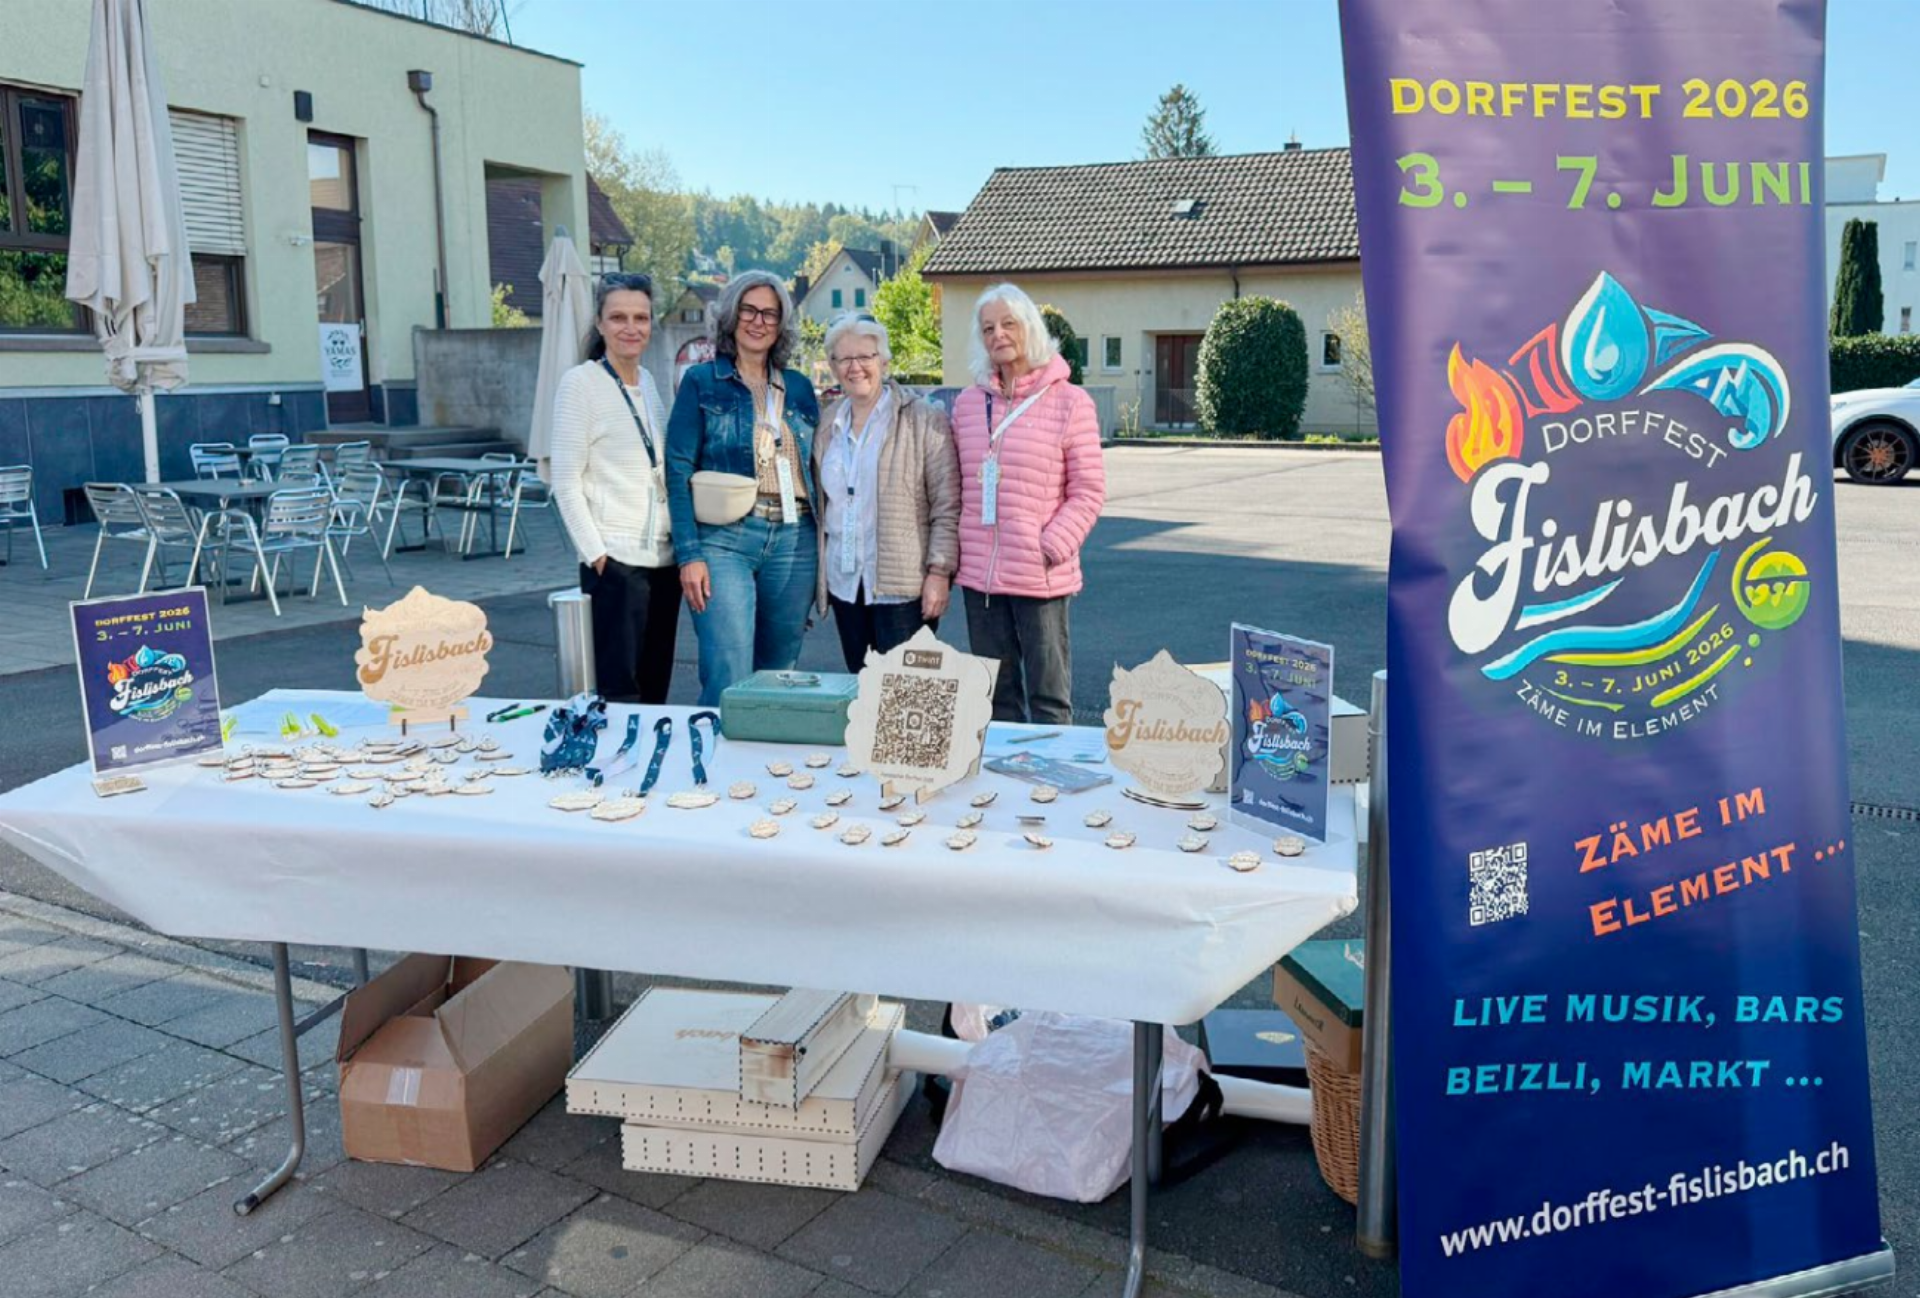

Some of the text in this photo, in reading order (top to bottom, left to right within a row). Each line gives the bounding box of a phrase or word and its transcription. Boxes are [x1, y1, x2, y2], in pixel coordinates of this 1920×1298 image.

[1389, 78, 1809, 119] DORFFEST 2026
[1396, 151, 1468, 209] 3.
[1556, 154, 1623, 210] 7.
[1650, 153, 1812, 206] JUNI
[325, 345, 357, 356] YAMAS
[1542, 410, 1728, 469] DORFFEST
[1448, 452, 1818, 655] Fislisbach
[95, 606, 191, 627] DORFFEST 2026
[96, 629, 113, 641] 3.
[131, 624, 149, 636] 7.
[154, 620, 191, 633] JUNI
[1245, 661, 1257, 675] 3.
[1293, 658, 1317, 673] 2026
[1554, 670, 1573, 688] 3.
[1601, 678, 1622, 694] 7.
[1631, 660, 1683, 693] JUNI
[1685, 622, 1736, 666] 2026
[110, 669, 195, 711] Fislisbach
[1515, 677, 1721, 740] ZÄME IM ELEMENT
[1106, 699, 1226, 751] Fislisbach
[1248, 721, 1312, 754] Fislisbach
[1574, 786, 1766, 873] ZÄME IM
[1587, 842, 1796, 937] ELEMENT
[1452, 993, 1845, 1029] LIVE MUSIK, BARS
[1445, 1062, 1601, 1096] BEIZLI,
[1621, 1059, 1771, 1089] MARKT
[1440, 1141, 1850, 1257] www.dorffest-fislisbach.ch
